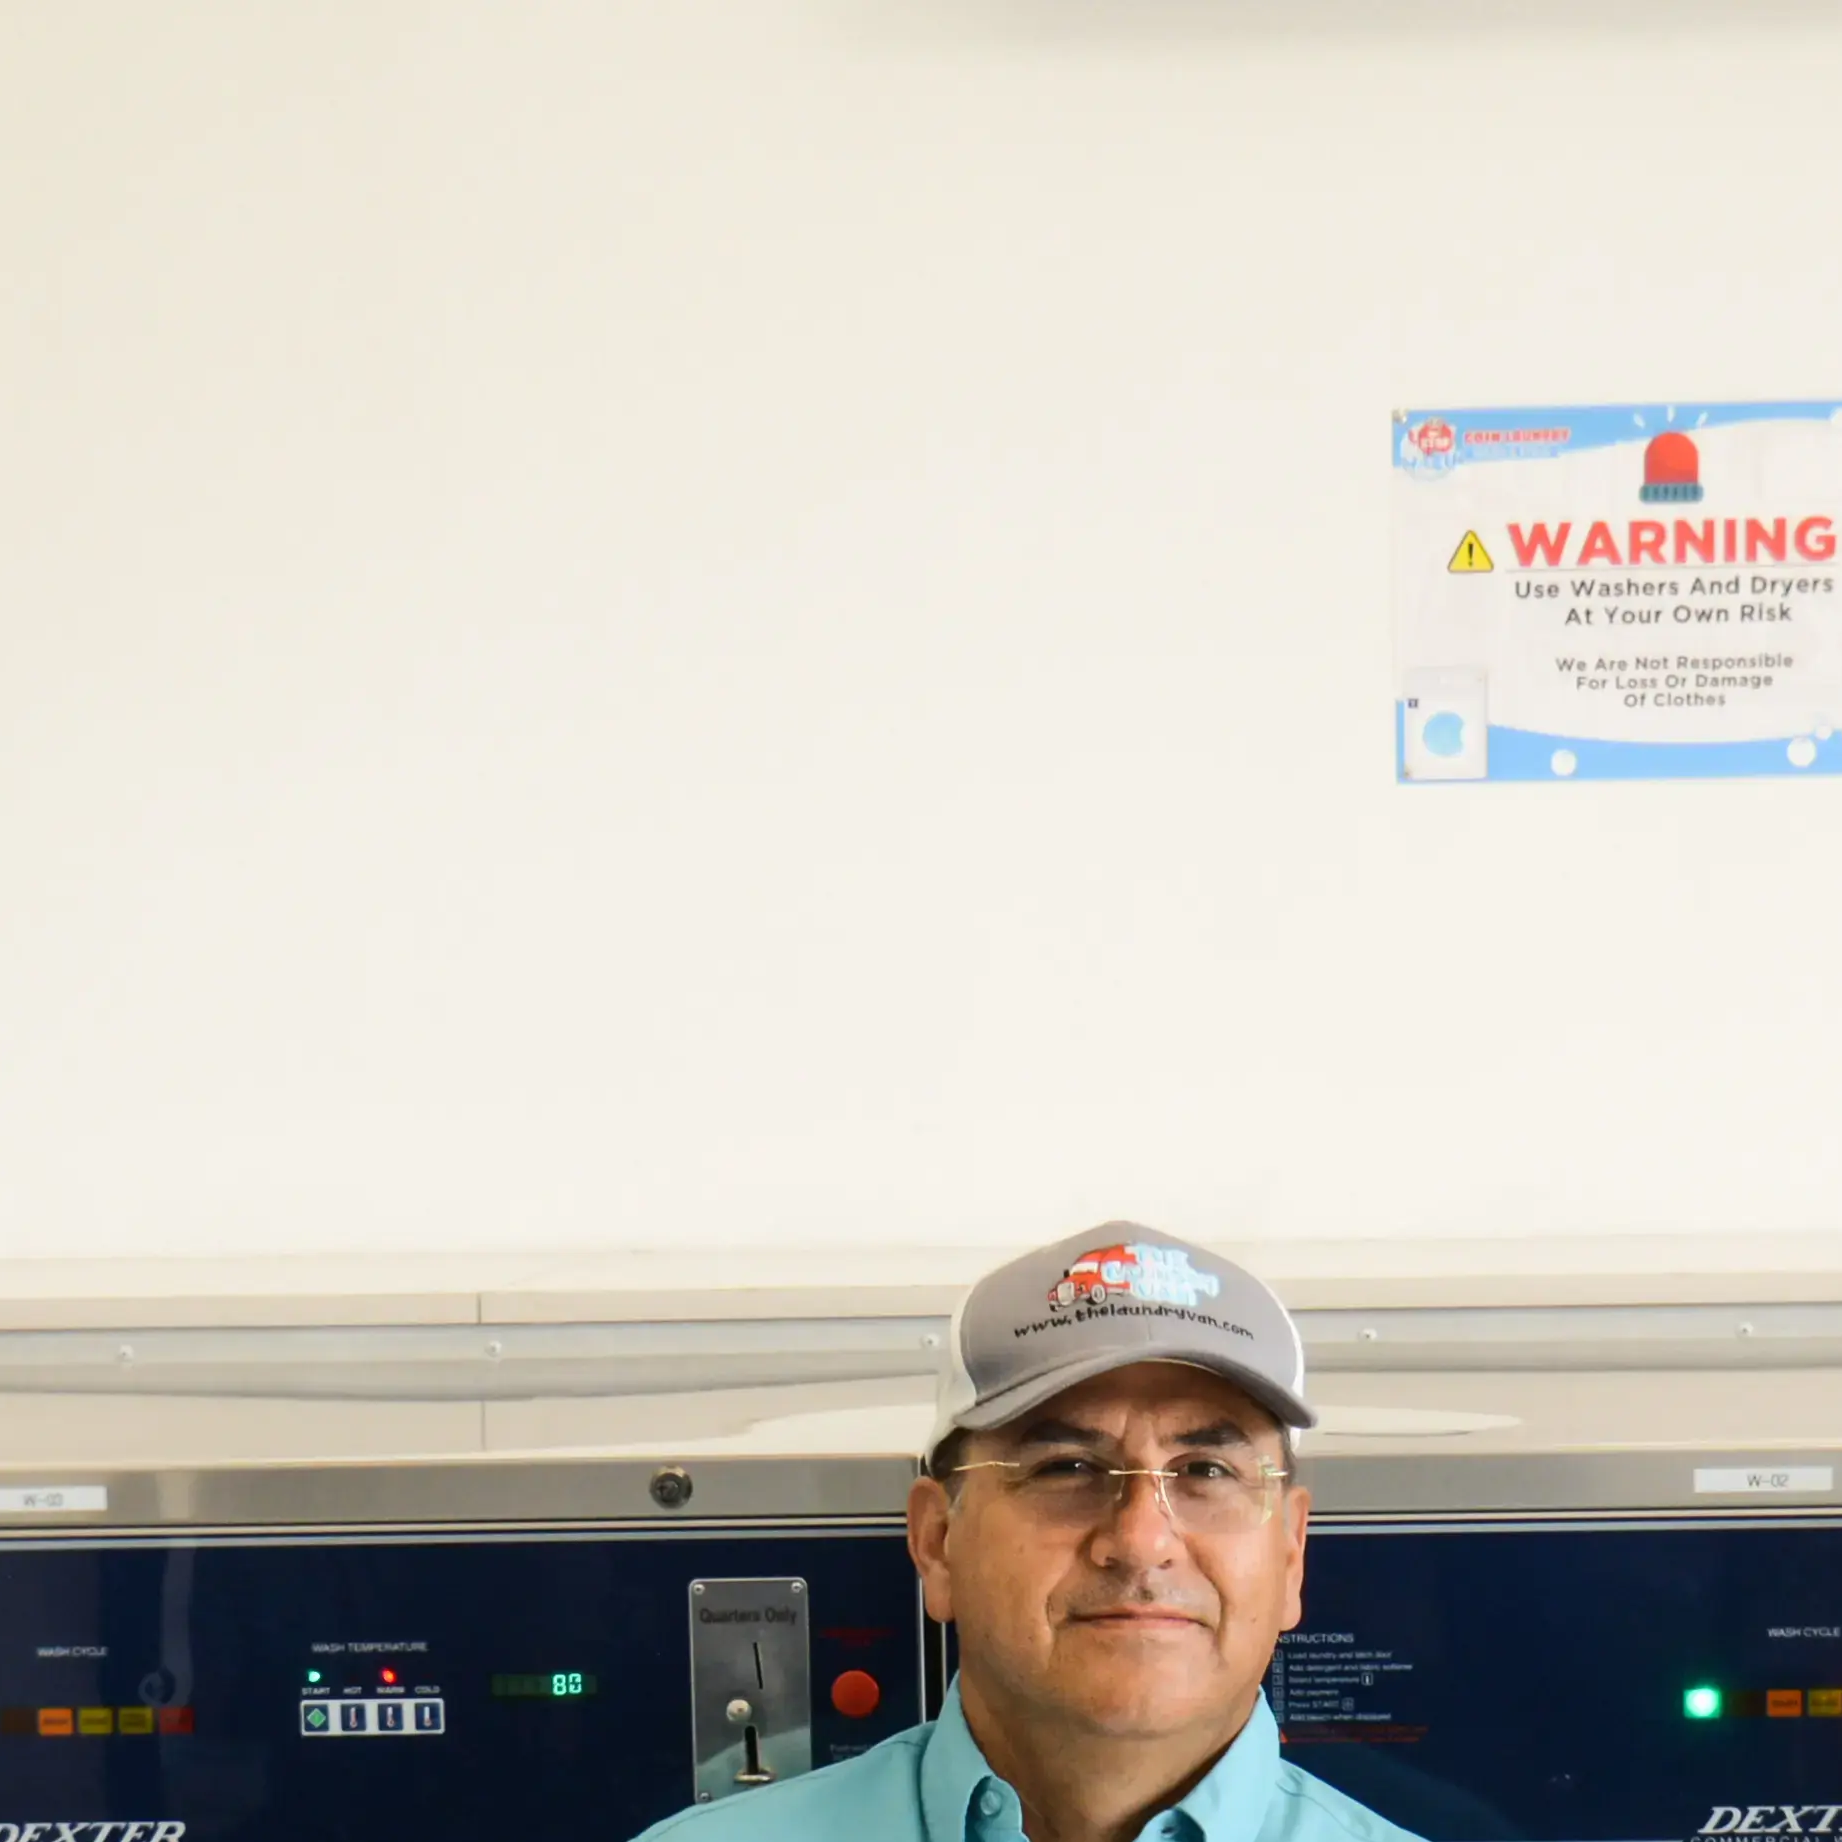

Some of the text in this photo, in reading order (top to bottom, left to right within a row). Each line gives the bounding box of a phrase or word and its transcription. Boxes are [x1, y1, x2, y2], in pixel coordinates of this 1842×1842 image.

[1507, 516, 1837, 568] WARNING
[1514, 575, 1835, 598] Use Washers And Dryers
[1564, 602, 1794, 626] At Your Own Risk
[1555, 653, 1794, 672] We Are Not Responsible
[1576, 672, 1774, 690] For Loss Or Damage
[1623, 691, 1727, 708] Of Clothes
[1746, 1473, 1789, 1488] W-02
[699, 1605, 798, 1626] Quarters Only
[1275, 1632, 1355, 1645] NSTRUCTIONS
[1766, 1626, 1842, 1638] WASH CYCLE
